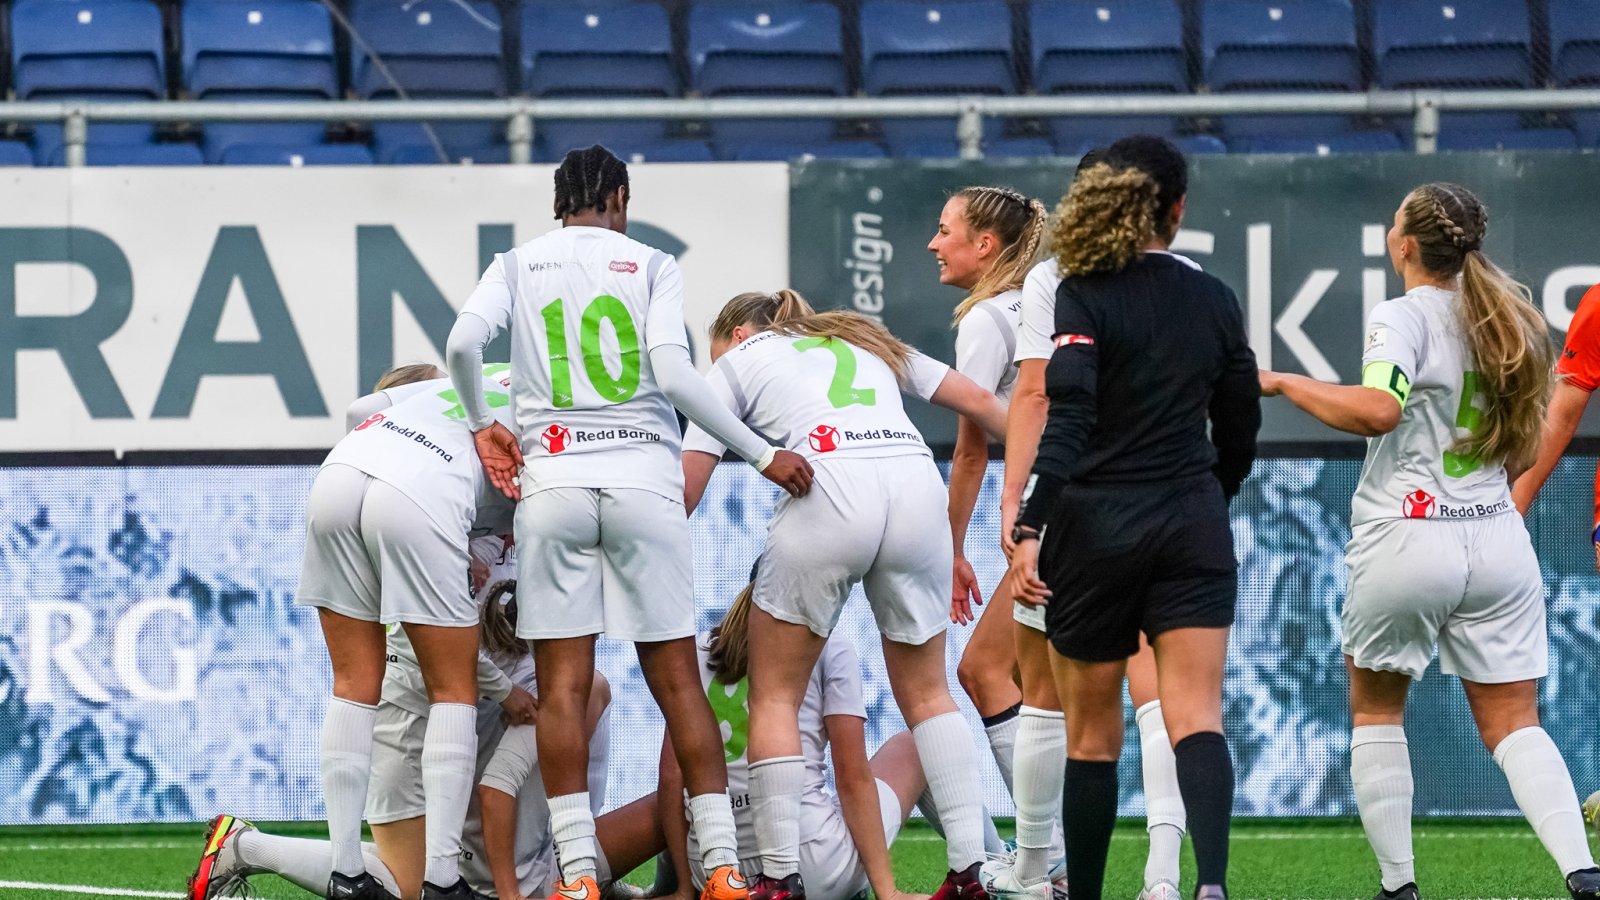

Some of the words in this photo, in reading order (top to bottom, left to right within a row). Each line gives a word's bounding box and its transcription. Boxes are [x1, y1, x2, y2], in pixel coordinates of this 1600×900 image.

[0, 223, 697, 420] RAN
[541, 294, 640, 408] 10
[792, 336, 876, 408] 2
[1389, 364, 1410, 402] C
[382, 420, 416, 438] Redd
[413, 433, 454, 463] Barna
[576, 429, 615, 442] Redd
[618, 429, 660, 442] Barna
[844, 429, 881, 441] Redd
[883, 429, 921, 442] Barna
[1440, 504, 1475, 518] Redd
[1476, 499, 1509, 516] Barna
